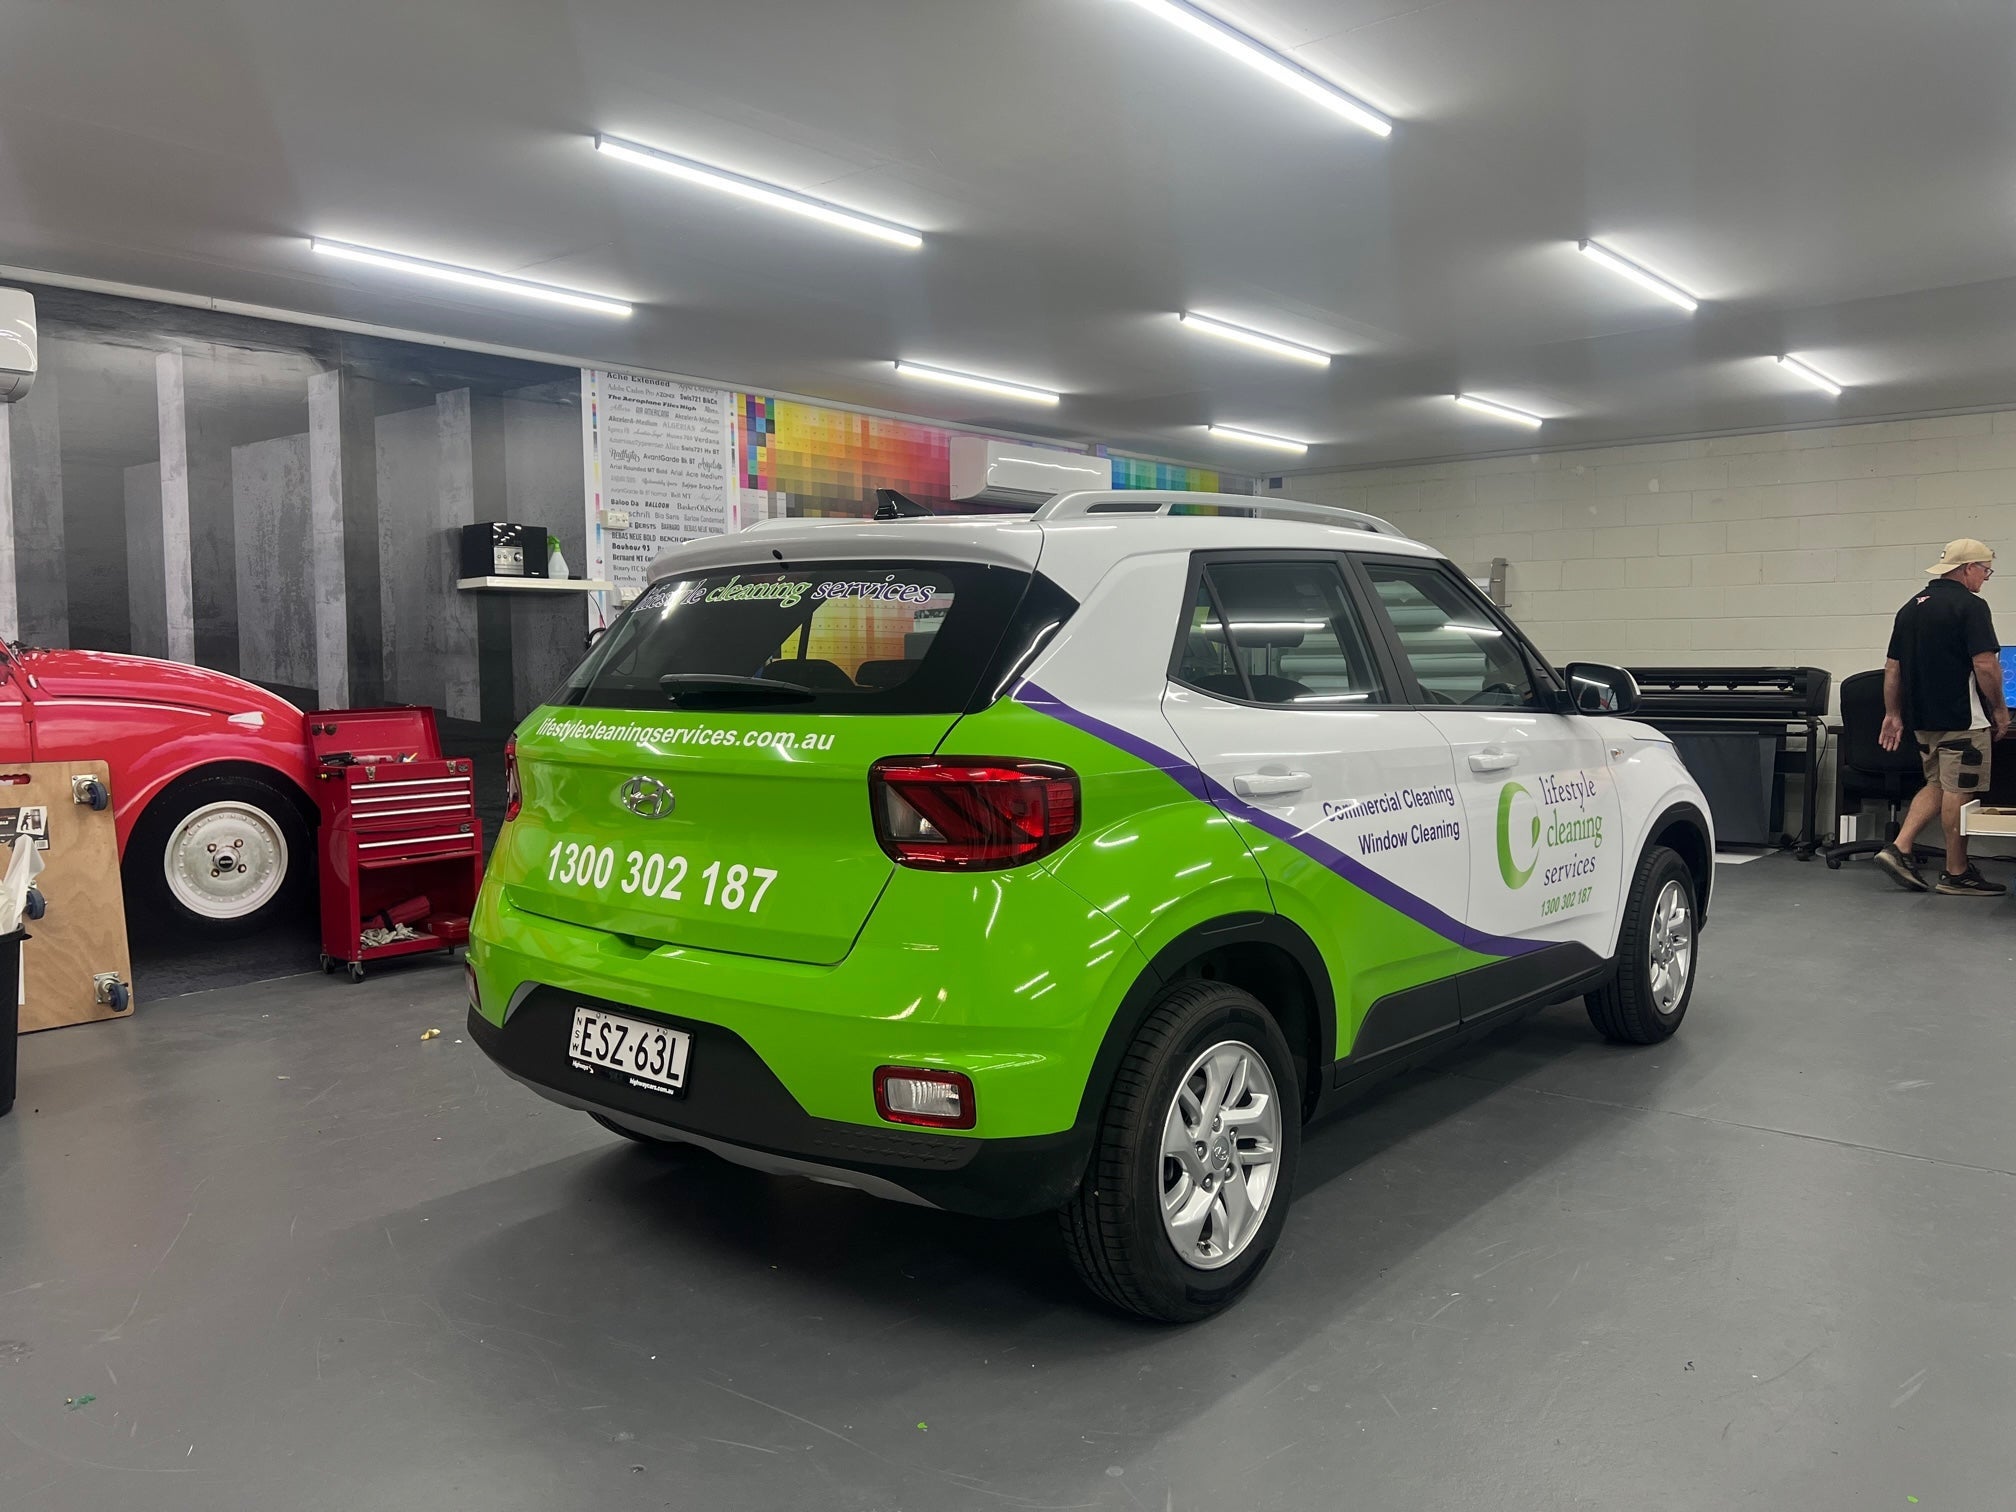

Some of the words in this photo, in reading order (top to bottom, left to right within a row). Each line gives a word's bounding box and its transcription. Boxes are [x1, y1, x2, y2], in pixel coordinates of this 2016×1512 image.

[622, 395, 661, 406] Aeroplane
[610, 498, 630, 506] Baloo
[645, 501, 670, 509] BALLOON
[612, 542, 641, 551] Bauhaus
[612, 553, 635, 562] Bernard
[705, 575, 812, 608] cleaning
[810, 574, 936, 604] services
[536, 717, 835, 750] lifestylecleaningservices.com.au
[1402, 786, 1456, 810] Cleaning
[1538, 771, 1597, 810] lifestyle
[1358, 825, 1408, 855] Window
[1410, 820, 1460, 843] Cleaning
[1546, 807, 1603, 848] cleaning
[548, 841, 615, 889] 1300
[621, 850, 688, 901] 302
[701, 860, 778, 913] 187
[1543, 853, 1596, 887] services
[1540, 896, 1560, 918] 1300
[1560, 892, 1576, 912] 302
[1577, 886, 1593, 905] 187
